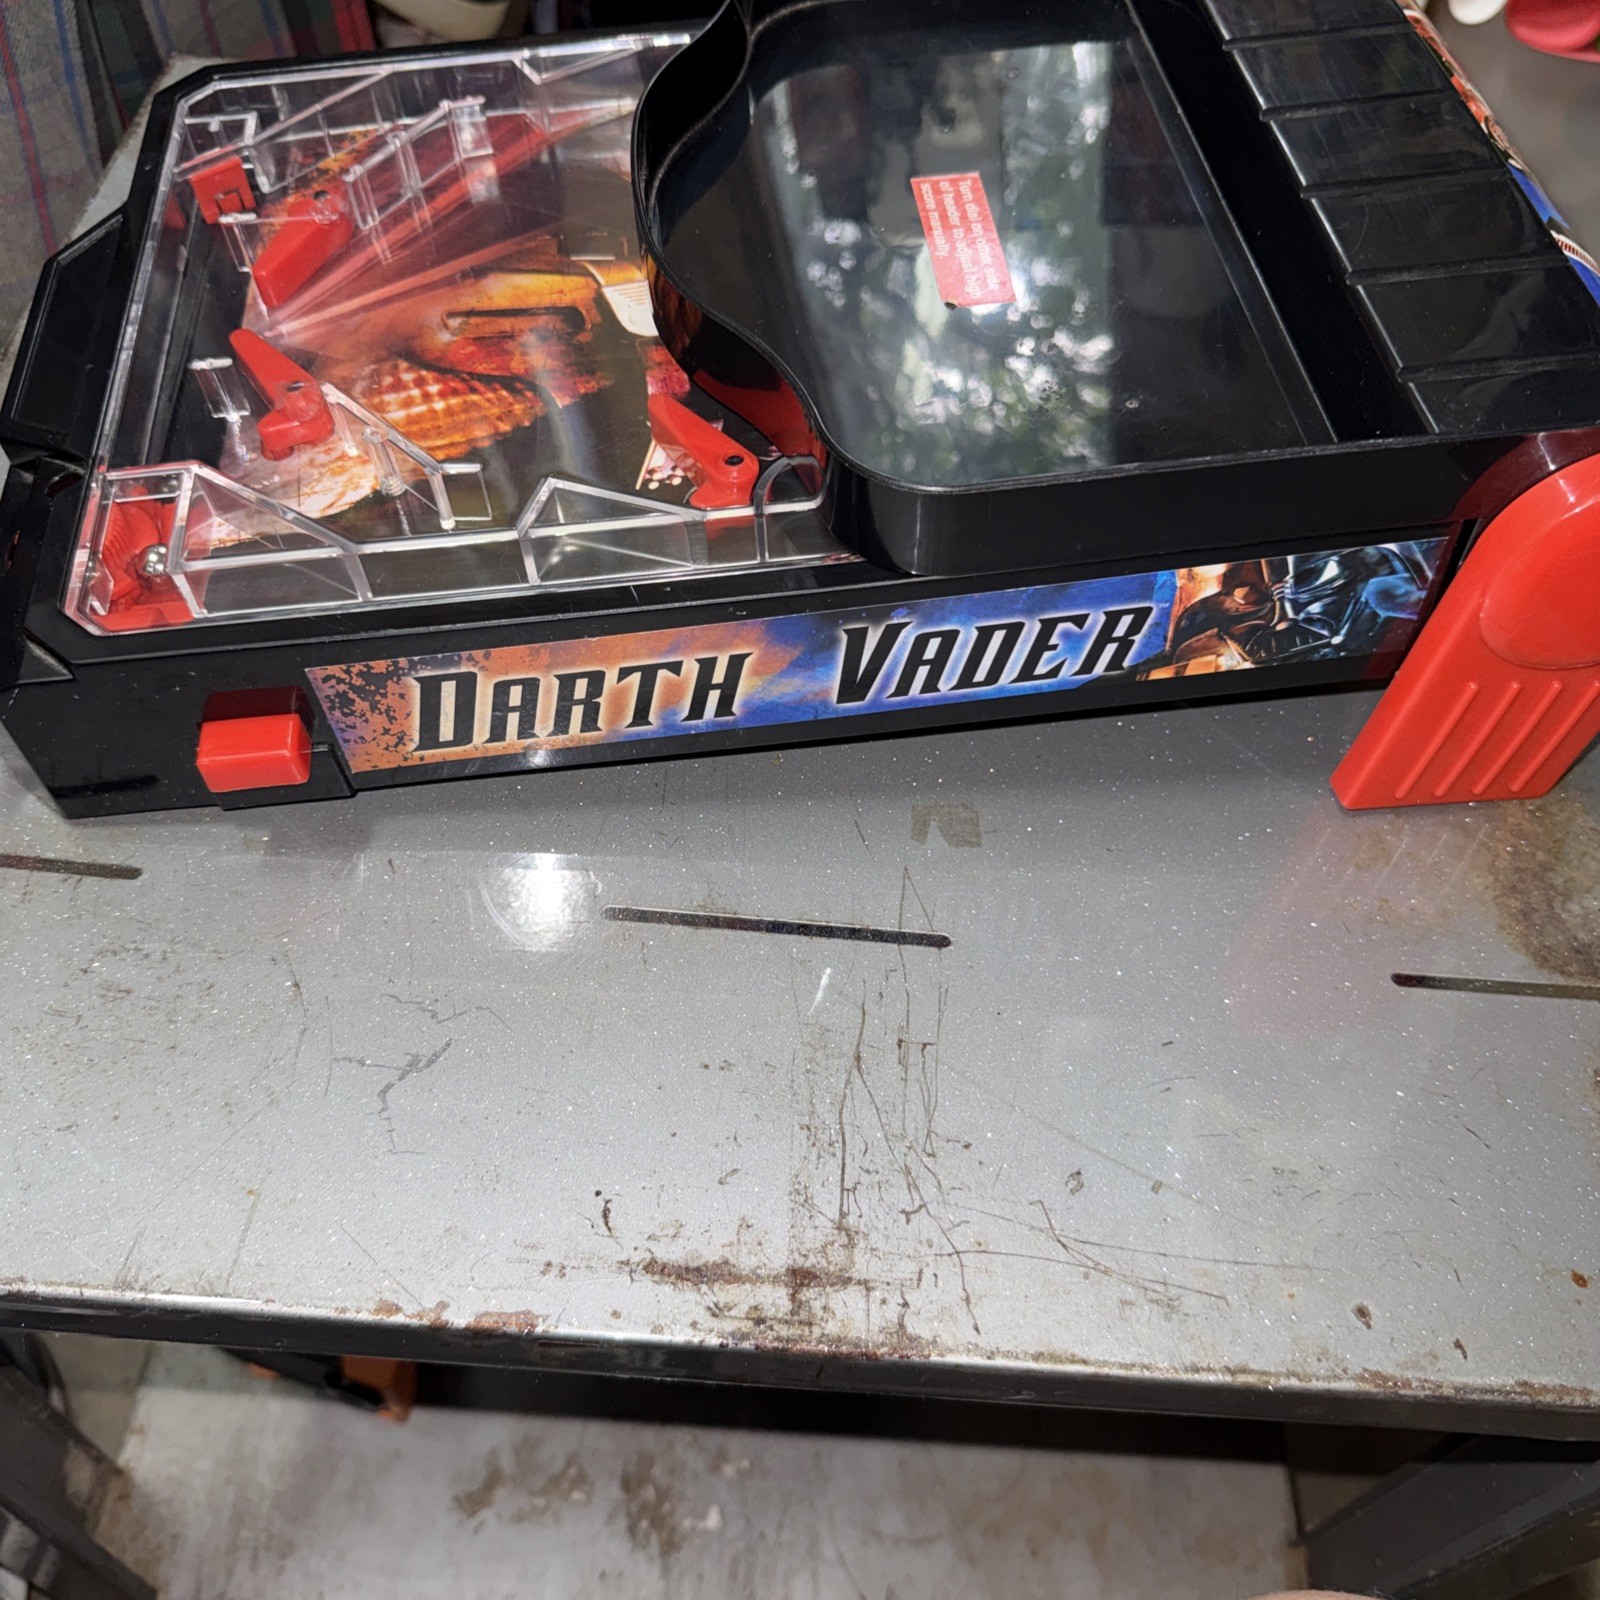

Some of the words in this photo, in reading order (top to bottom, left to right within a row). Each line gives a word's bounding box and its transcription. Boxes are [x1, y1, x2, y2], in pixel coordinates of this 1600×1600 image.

[939, 181, 952, 192] of
[920, 182, 936, 209] score
[928, 210, 951, 259] manually.
[942, 193, 962, 226] header
[965, 203, 980, 221] dial
[952, 228, 963, 239] to
[971, 223, 983, 236] on
[955, 240, 976, 272] adjust
[975, 238, 993, 265] other
[964, 272, 982, 299] high
[983, 267, 1000, 290] side
